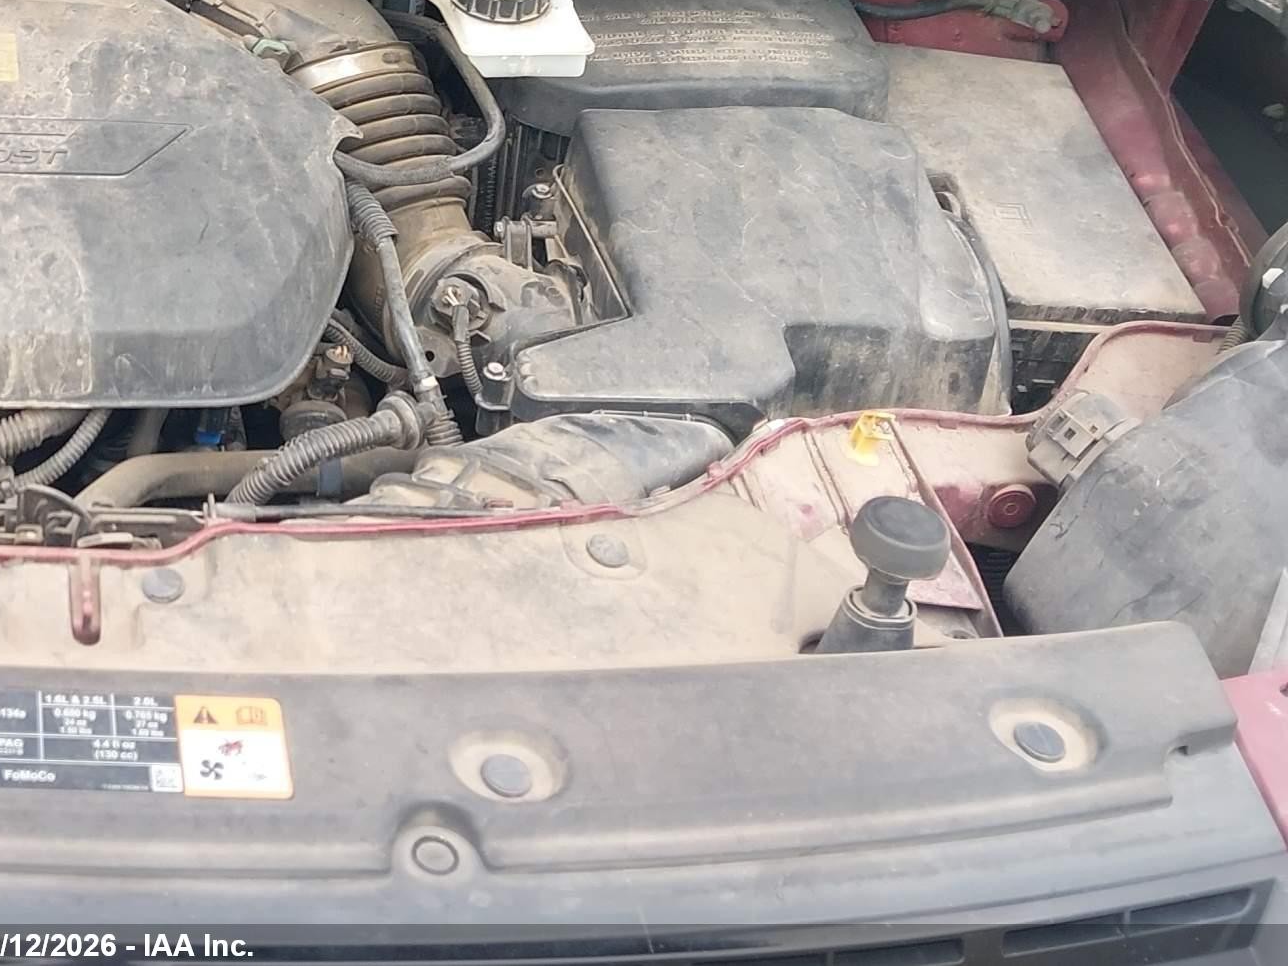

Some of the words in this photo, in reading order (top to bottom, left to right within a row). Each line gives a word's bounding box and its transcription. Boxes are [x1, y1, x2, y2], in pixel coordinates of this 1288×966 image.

[133, 696, 158, 707] 2.0L
[82, 708, 97, 722] kg
[153, 711, 168, 724] kg
[2, 769, 56, 783] FoMoCo
